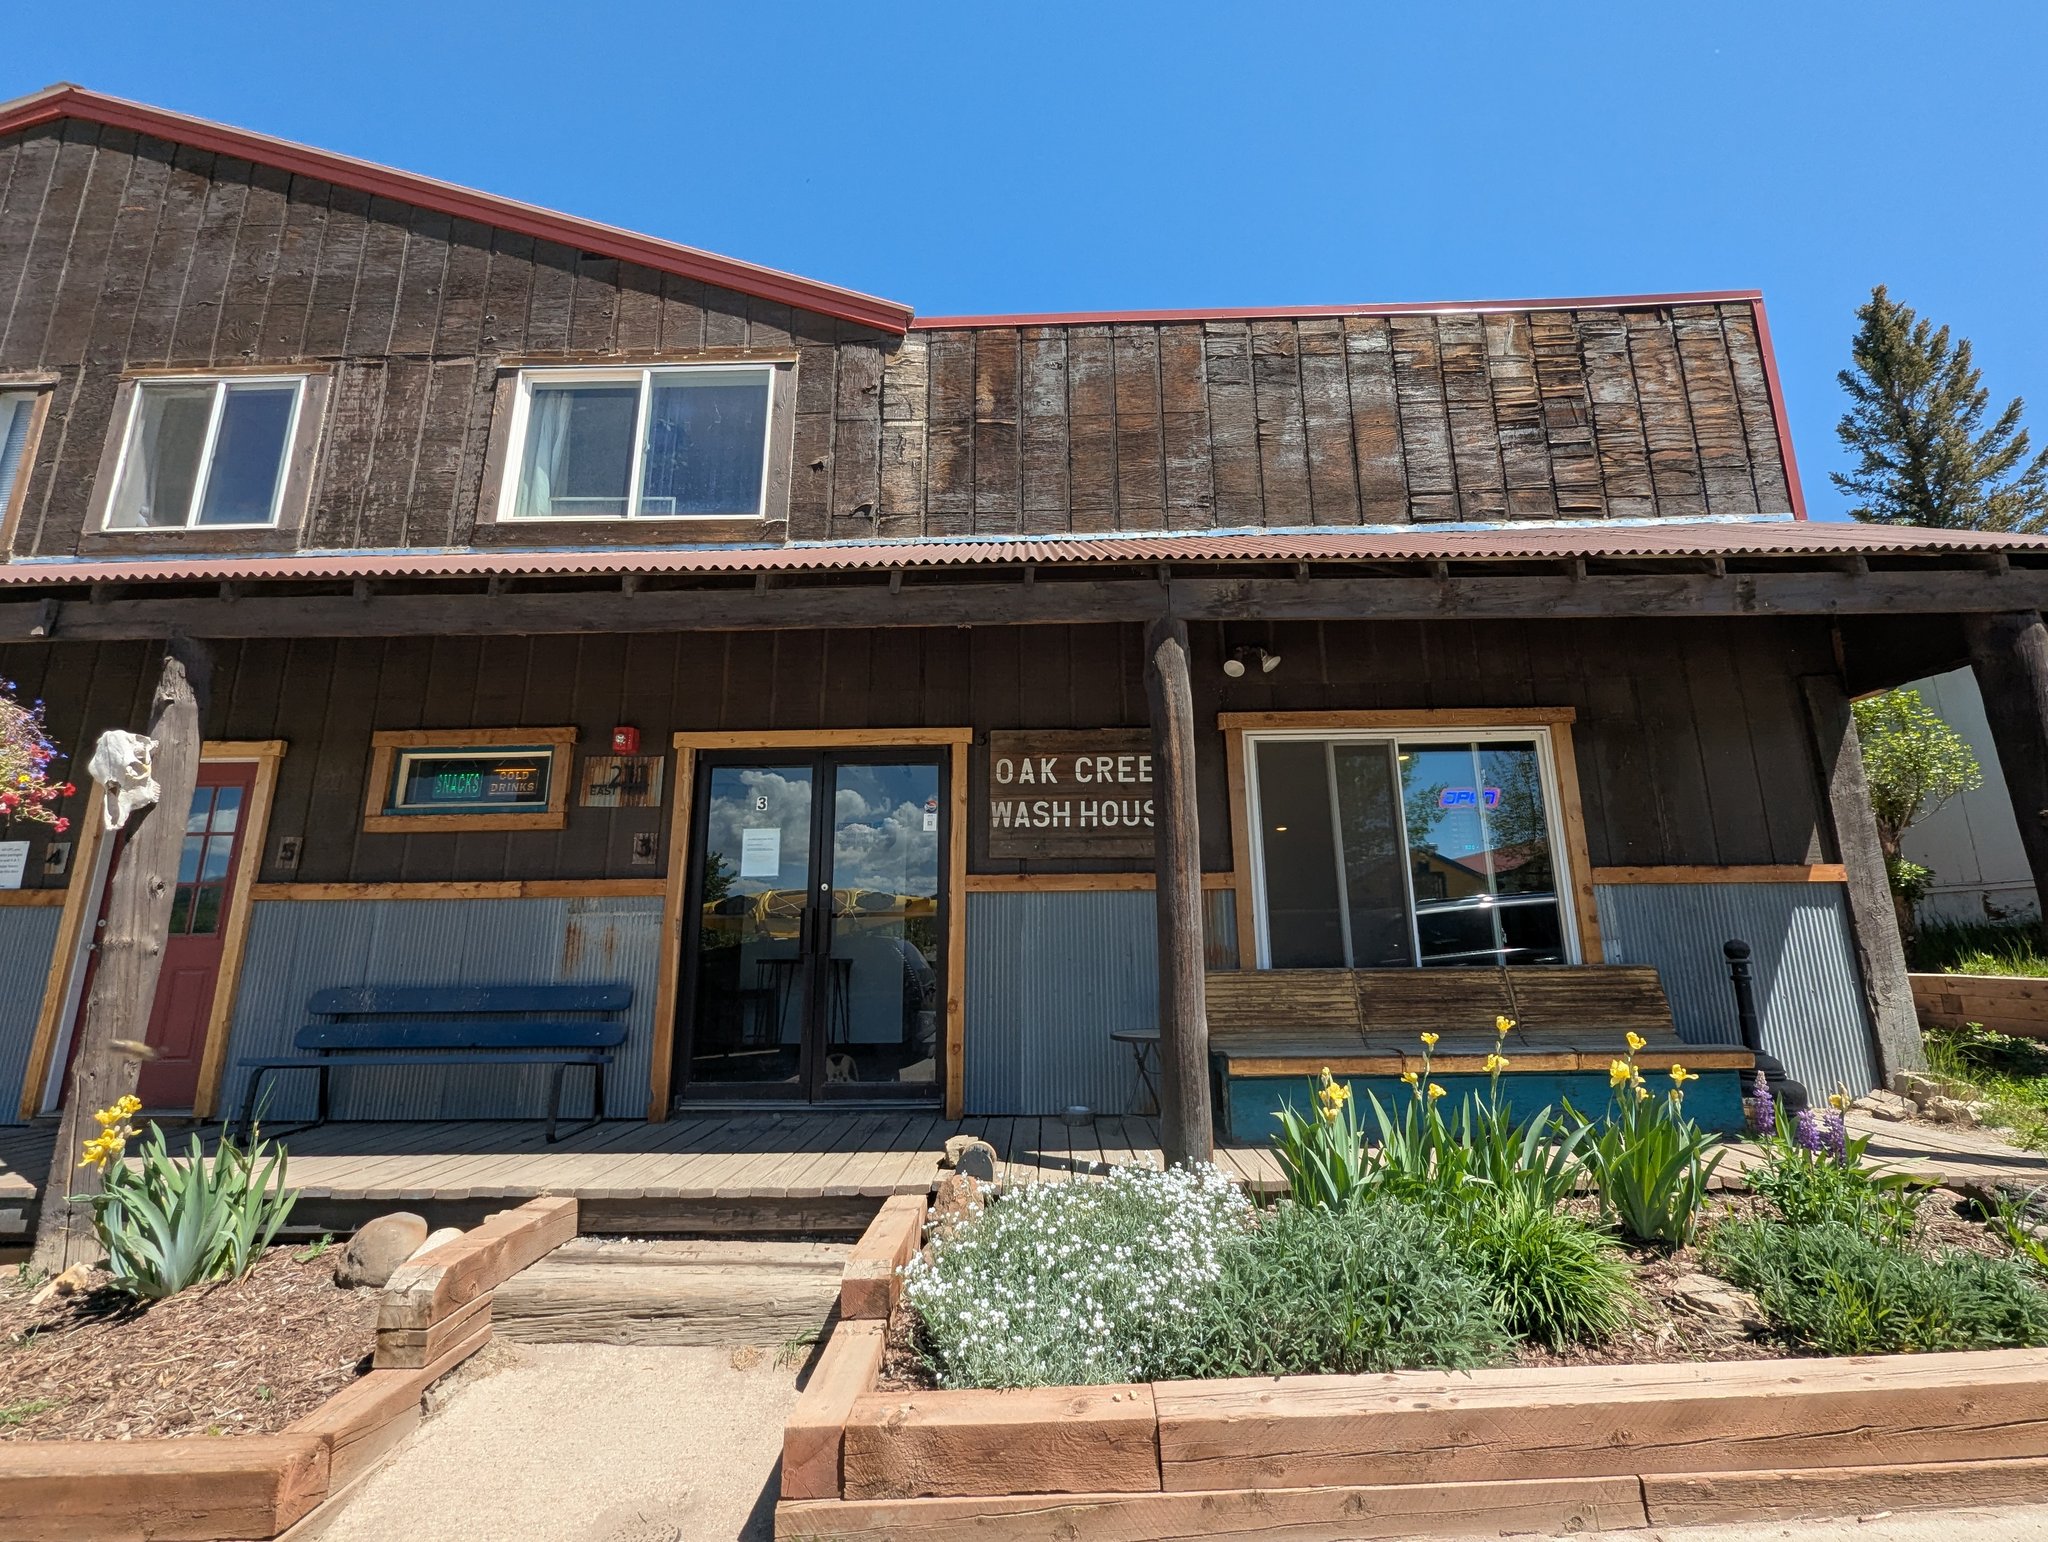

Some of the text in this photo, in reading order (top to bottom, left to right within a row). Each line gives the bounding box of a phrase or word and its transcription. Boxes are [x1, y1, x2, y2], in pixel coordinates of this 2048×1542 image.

[500, 771, 529, 780] COLD
[996, 755, 1153, 784] OAK CREE
[436, 773, 479, 793] SNACKS
[491, 783, 534, 792] DRINKS
[590, 785, 617, 796] EAST
[757, 797, 766, 810] 3
[991, 800, 1155, 828] WASH HOUS
[636, 839, 652, 857] 3
